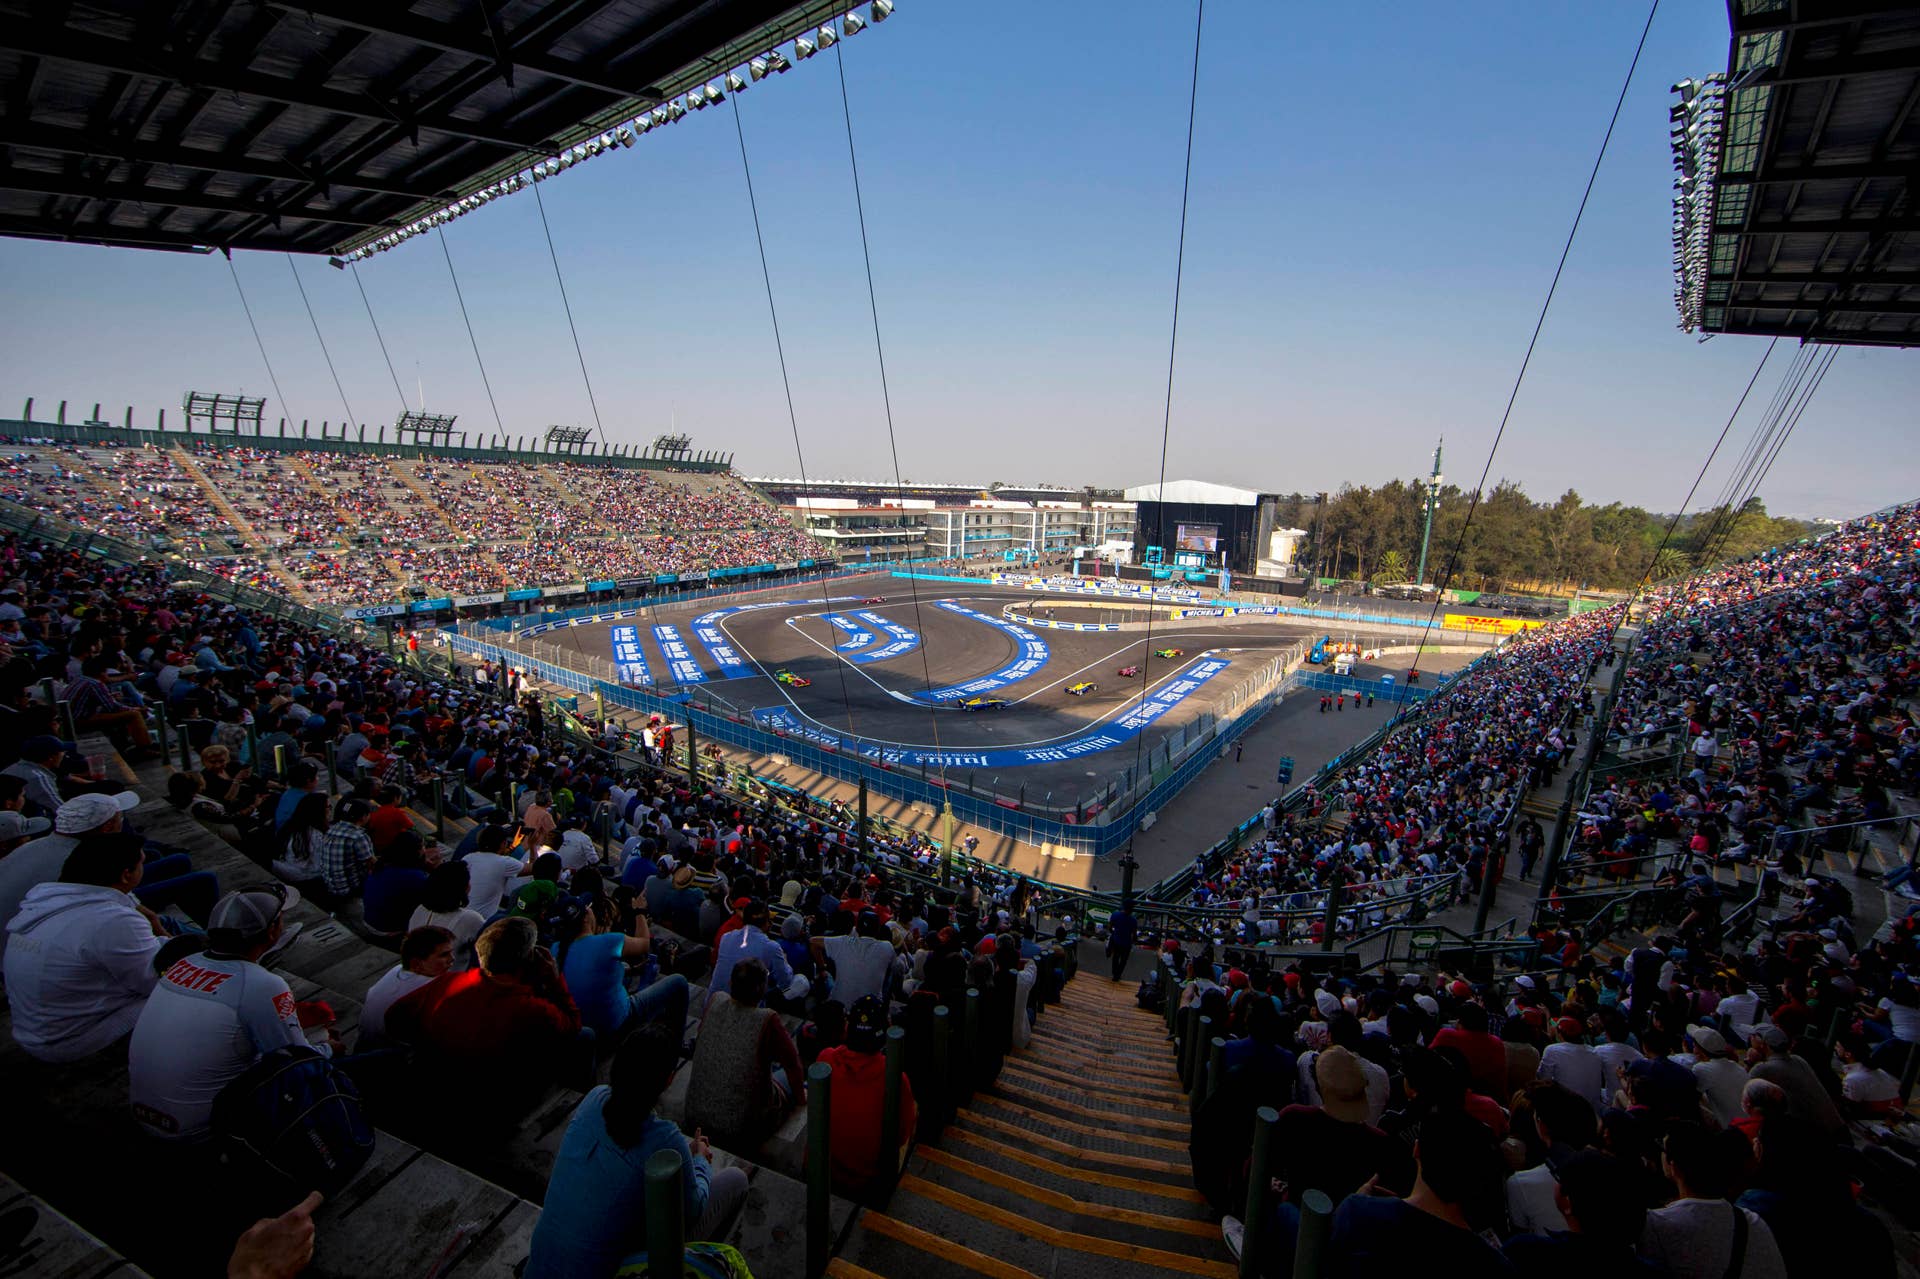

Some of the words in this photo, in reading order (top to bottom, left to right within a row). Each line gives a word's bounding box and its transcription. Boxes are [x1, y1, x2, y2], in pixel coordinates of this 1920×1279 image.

[1156, 588, 1197, 597] MICHELIN
[356, 606, 394, 617] OCESA
[1067, 735, 1122, 754] Julius
[1026, 750, 1070, 760] Bär
[916, 756, 989, 766] Julius
[166, 960, 233, 993] TECATE
